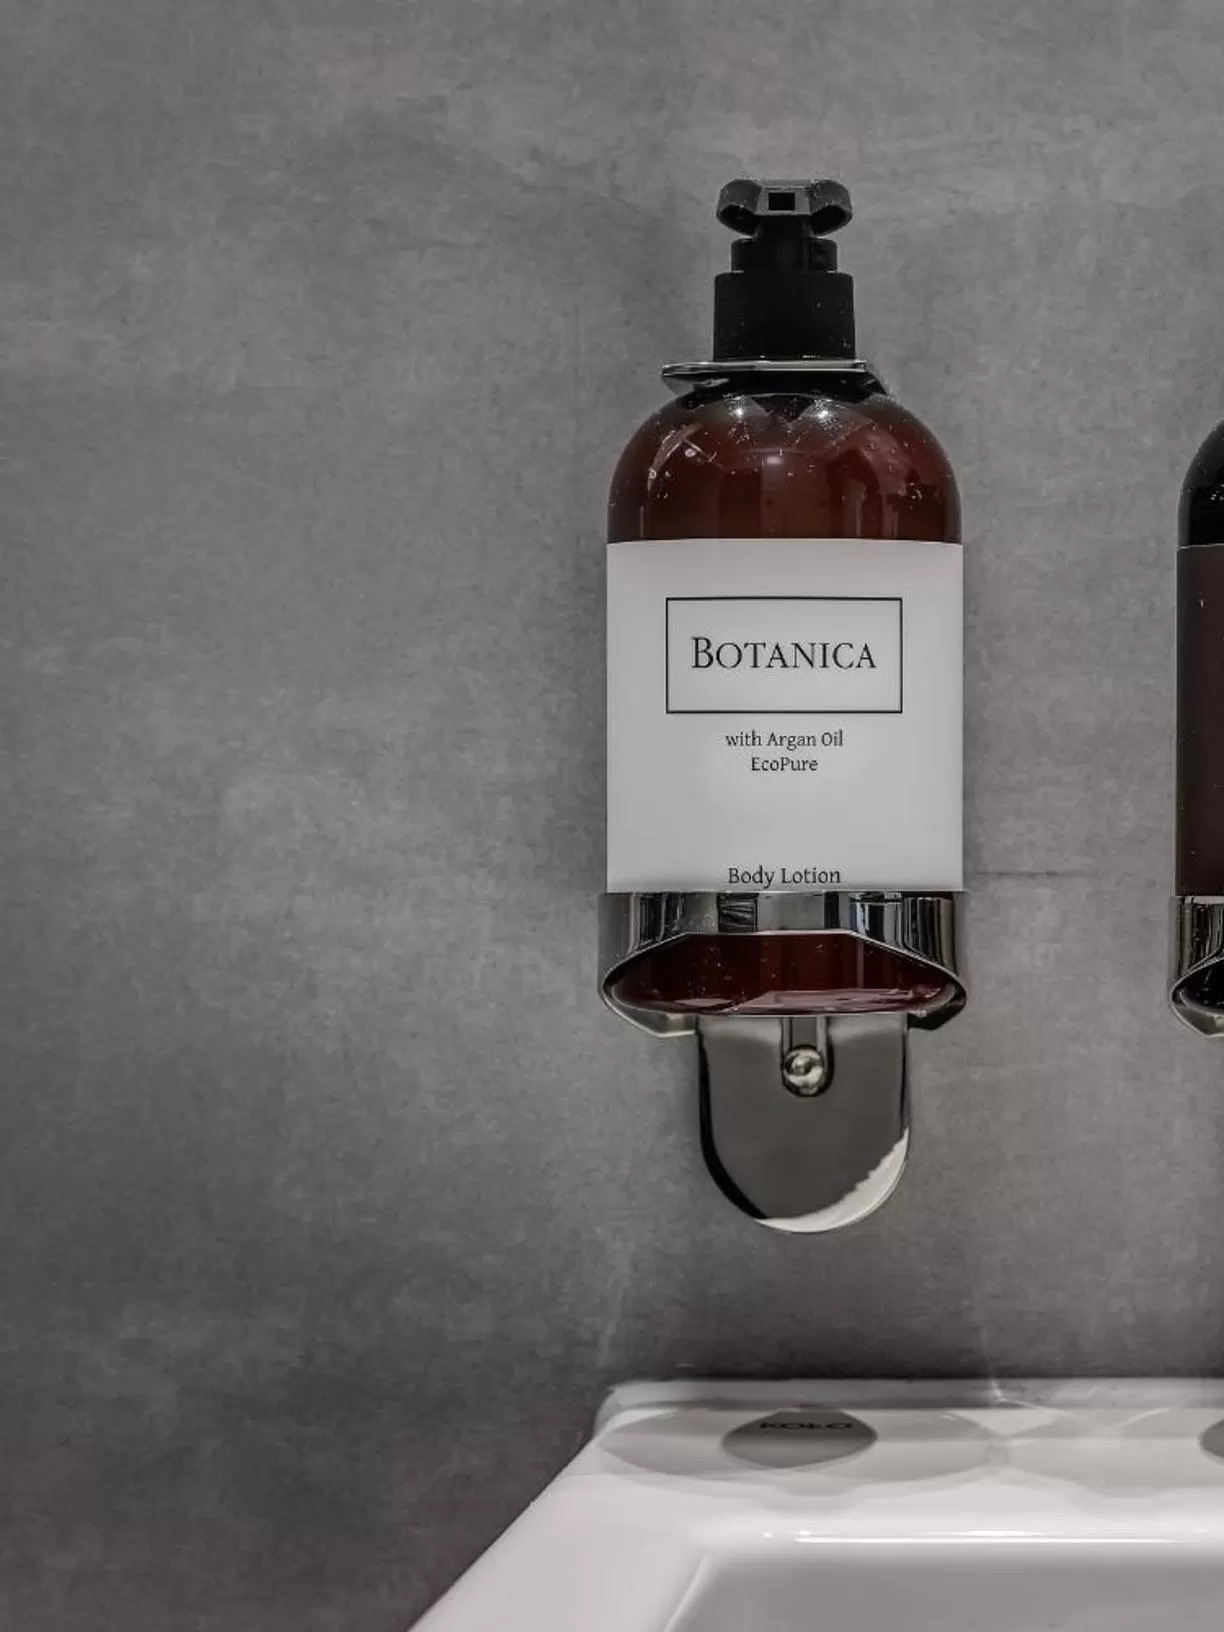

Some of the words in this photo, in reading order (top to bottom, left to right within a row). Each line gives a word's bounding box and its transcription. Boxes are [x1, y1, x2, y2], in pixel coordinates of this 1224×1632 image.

[725, 729, 762, 747] with
[766, 730, 817, 751] Argan
[820, 729, 843, 747] Oil
[750, 756, 819, 772] EcoPure
[728, 865, 775, 887] Body
[780, 866, 841, 884] Lotion
